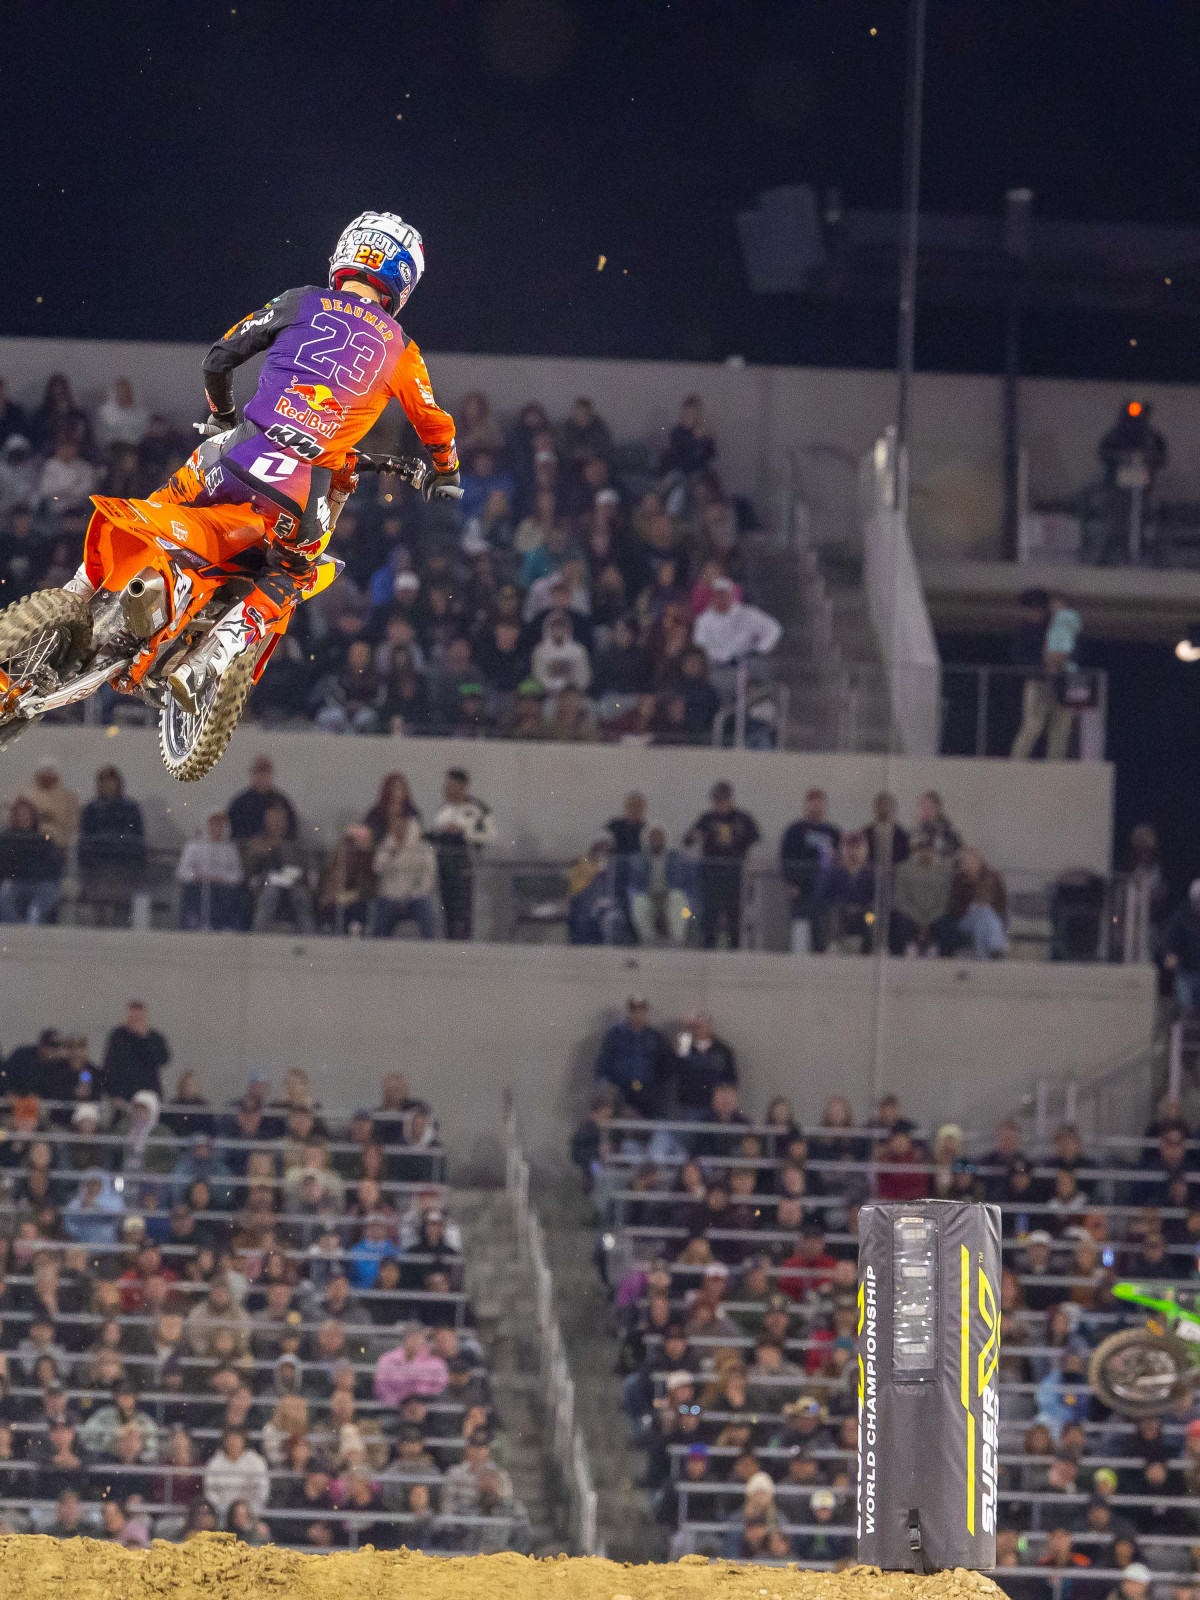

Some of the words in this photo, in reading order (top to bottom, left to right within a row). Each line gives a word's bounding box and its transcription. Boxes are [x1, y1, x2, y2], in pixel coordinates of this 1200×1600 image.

[353, 244, 386, 270] 23
[294, 312, 387, 396] 23
[320, 298, 394, 342] BEAUMER
[264, 423, 325, 461] KTM
[866, 1264, 877, 1447] CHAMPIONSHIP
[865, 1450, 877, 1535] WORLD
[981, 1384, 996, 1536] SUPER
